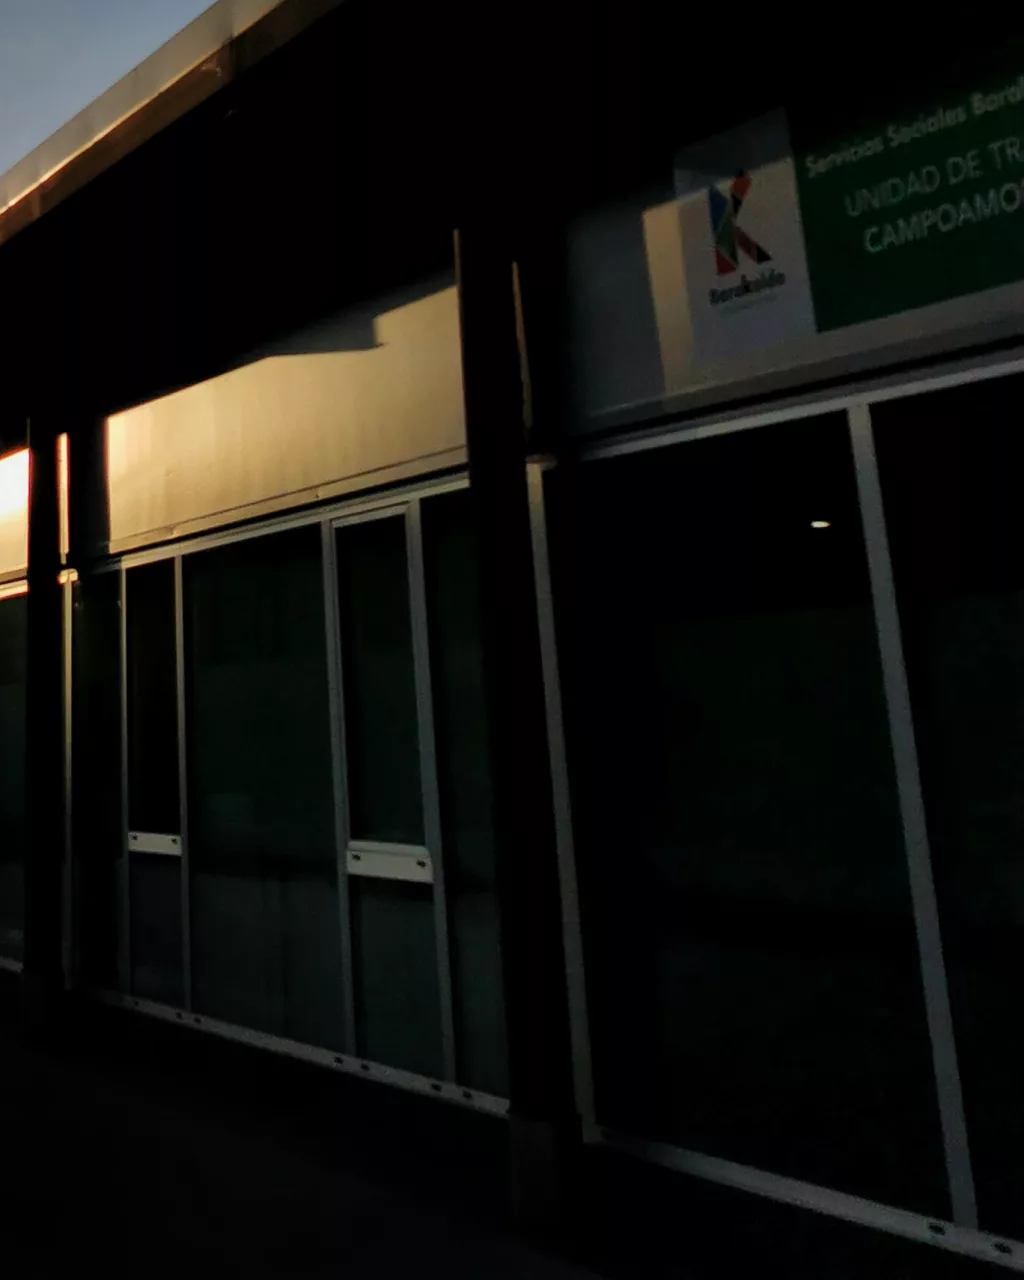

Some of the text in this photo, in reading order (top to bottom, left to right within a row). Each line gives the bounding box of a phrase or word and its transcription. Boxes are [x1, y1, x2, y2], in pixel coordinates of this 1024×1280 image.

[887, 106, 967, 148] Sociales
[844, 136, 1024, 218] UNIDAD DE TR
[863, 179, 1024, 255] CAMPOAMO
